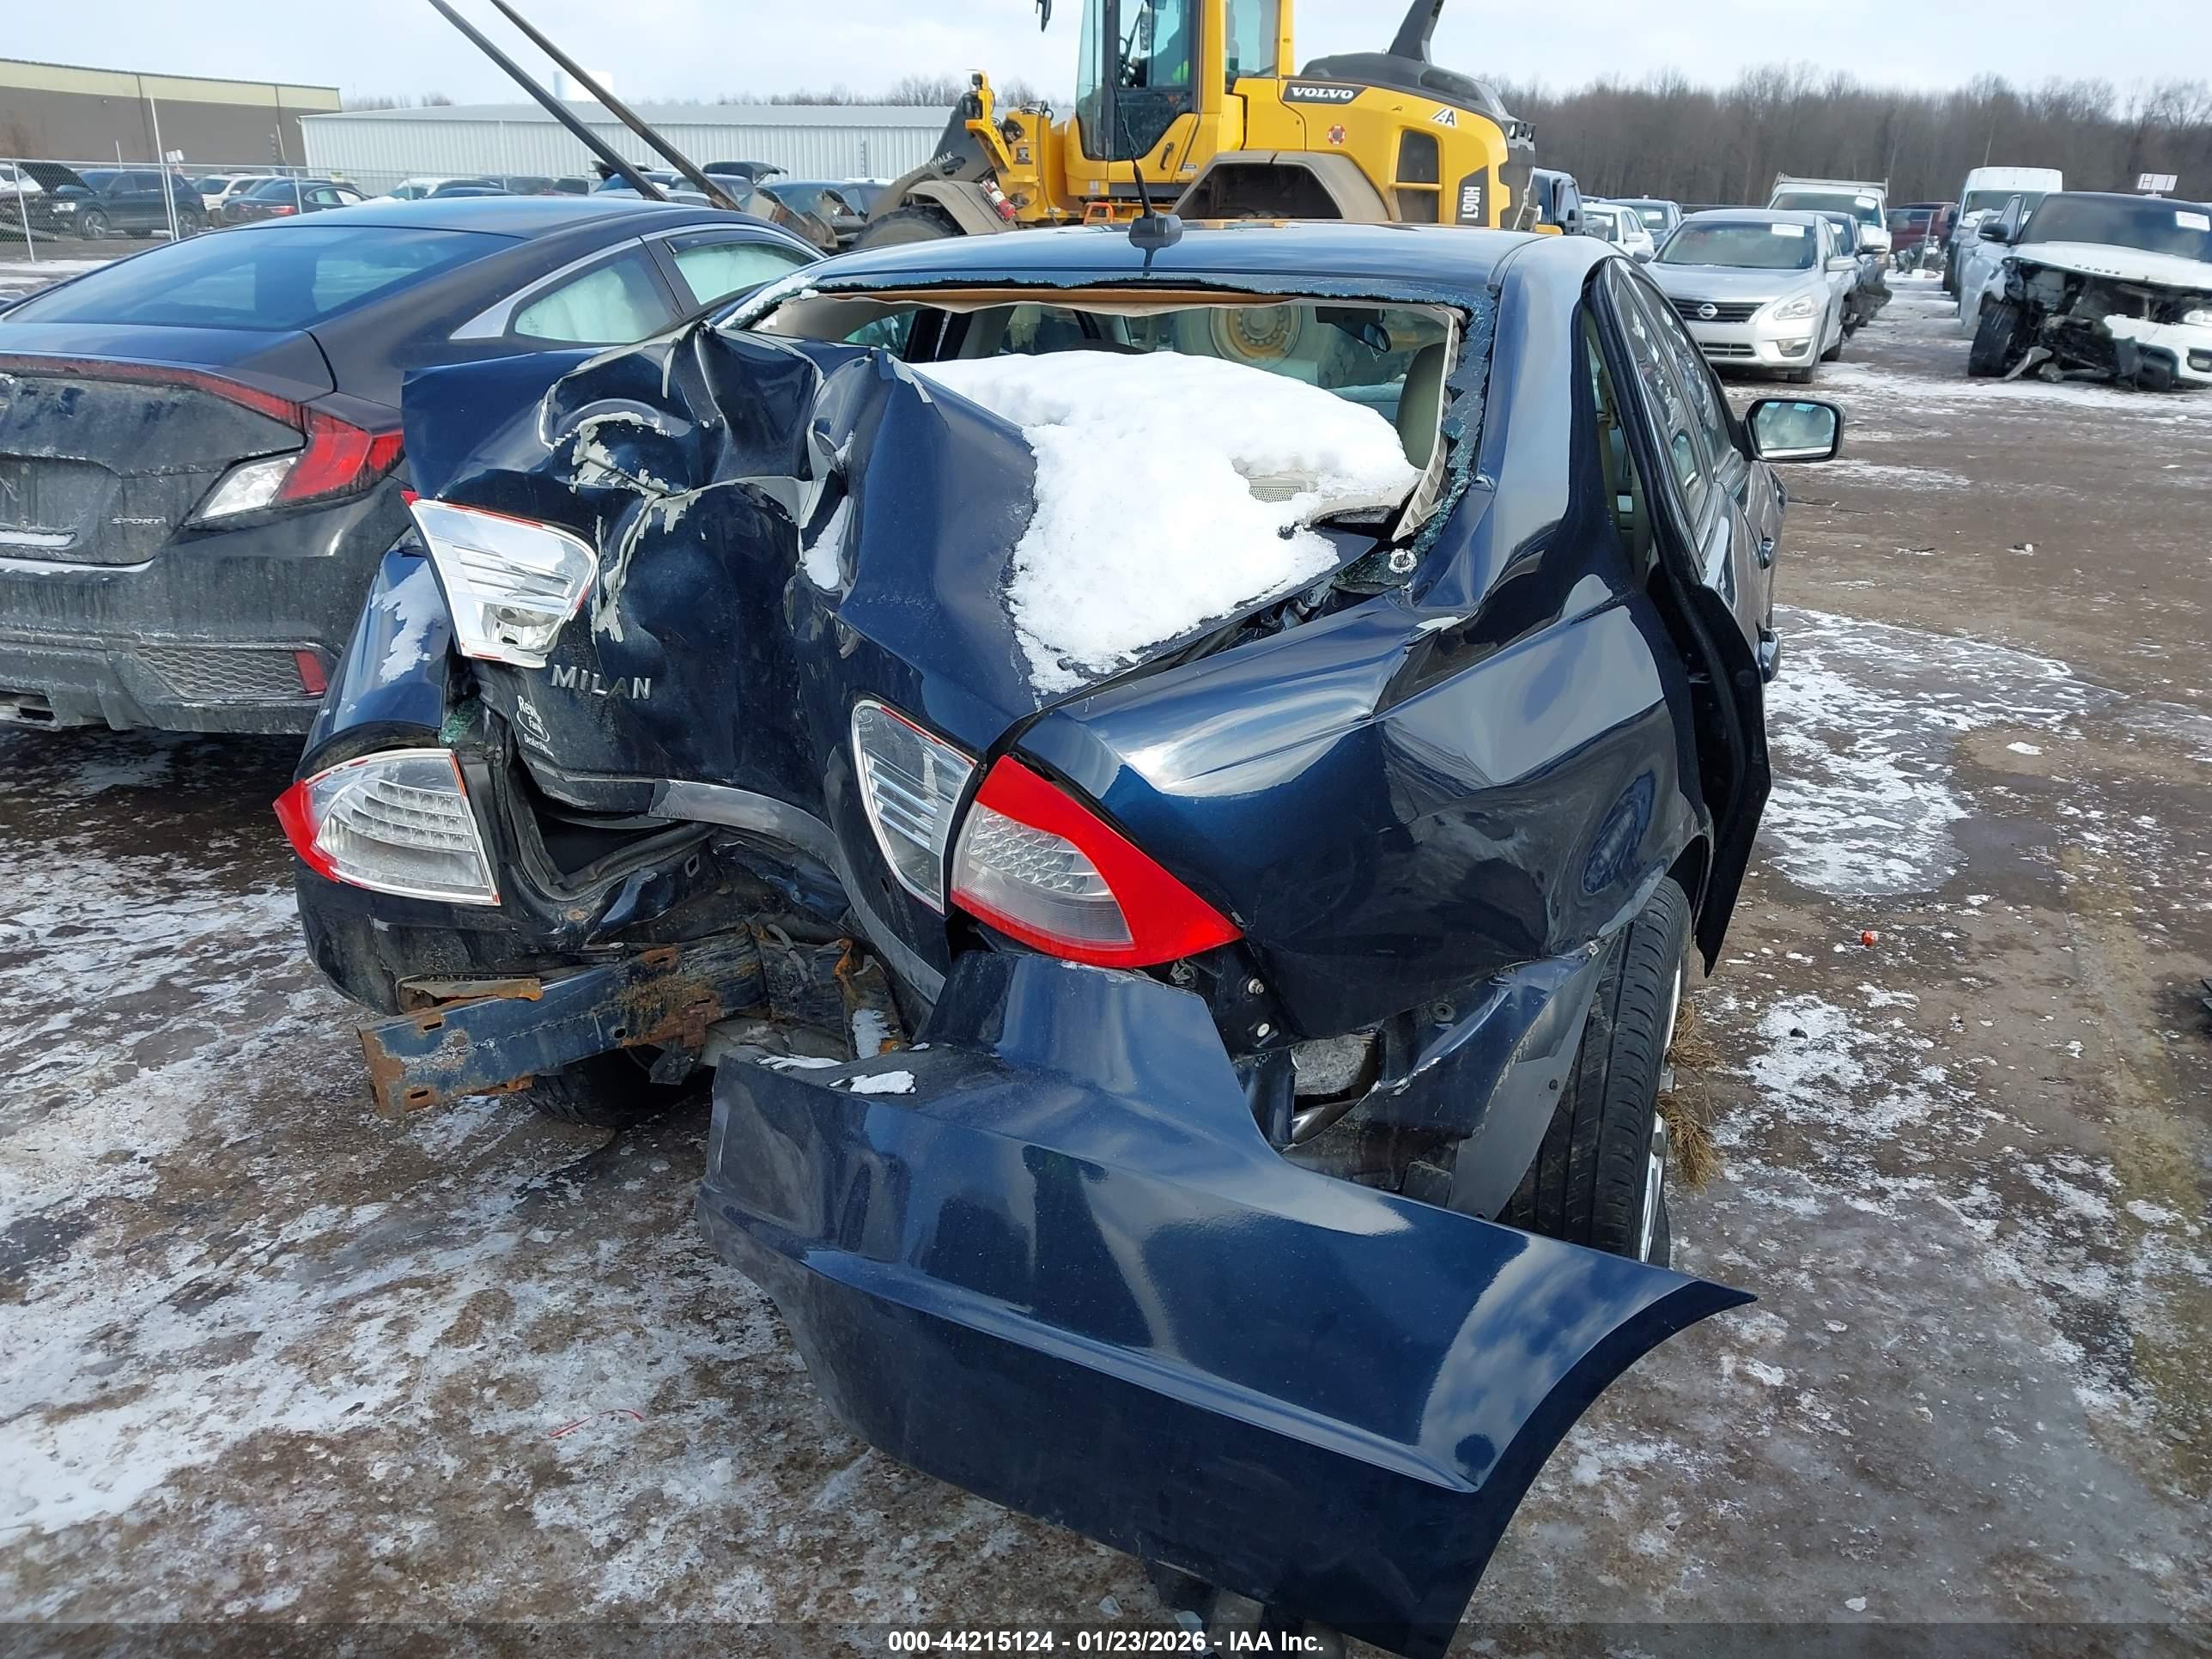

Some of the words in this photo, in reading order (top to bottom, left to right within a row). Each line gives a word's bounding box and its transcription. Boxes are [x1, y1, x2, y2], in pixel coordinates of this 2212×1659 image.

[1291, 87, 1354, 100] VOLVO
[1462, 185, 1481, 219] L90H
[110, 517, 166, 526] SPORT
[550, 664, 652, 701] MILAN
